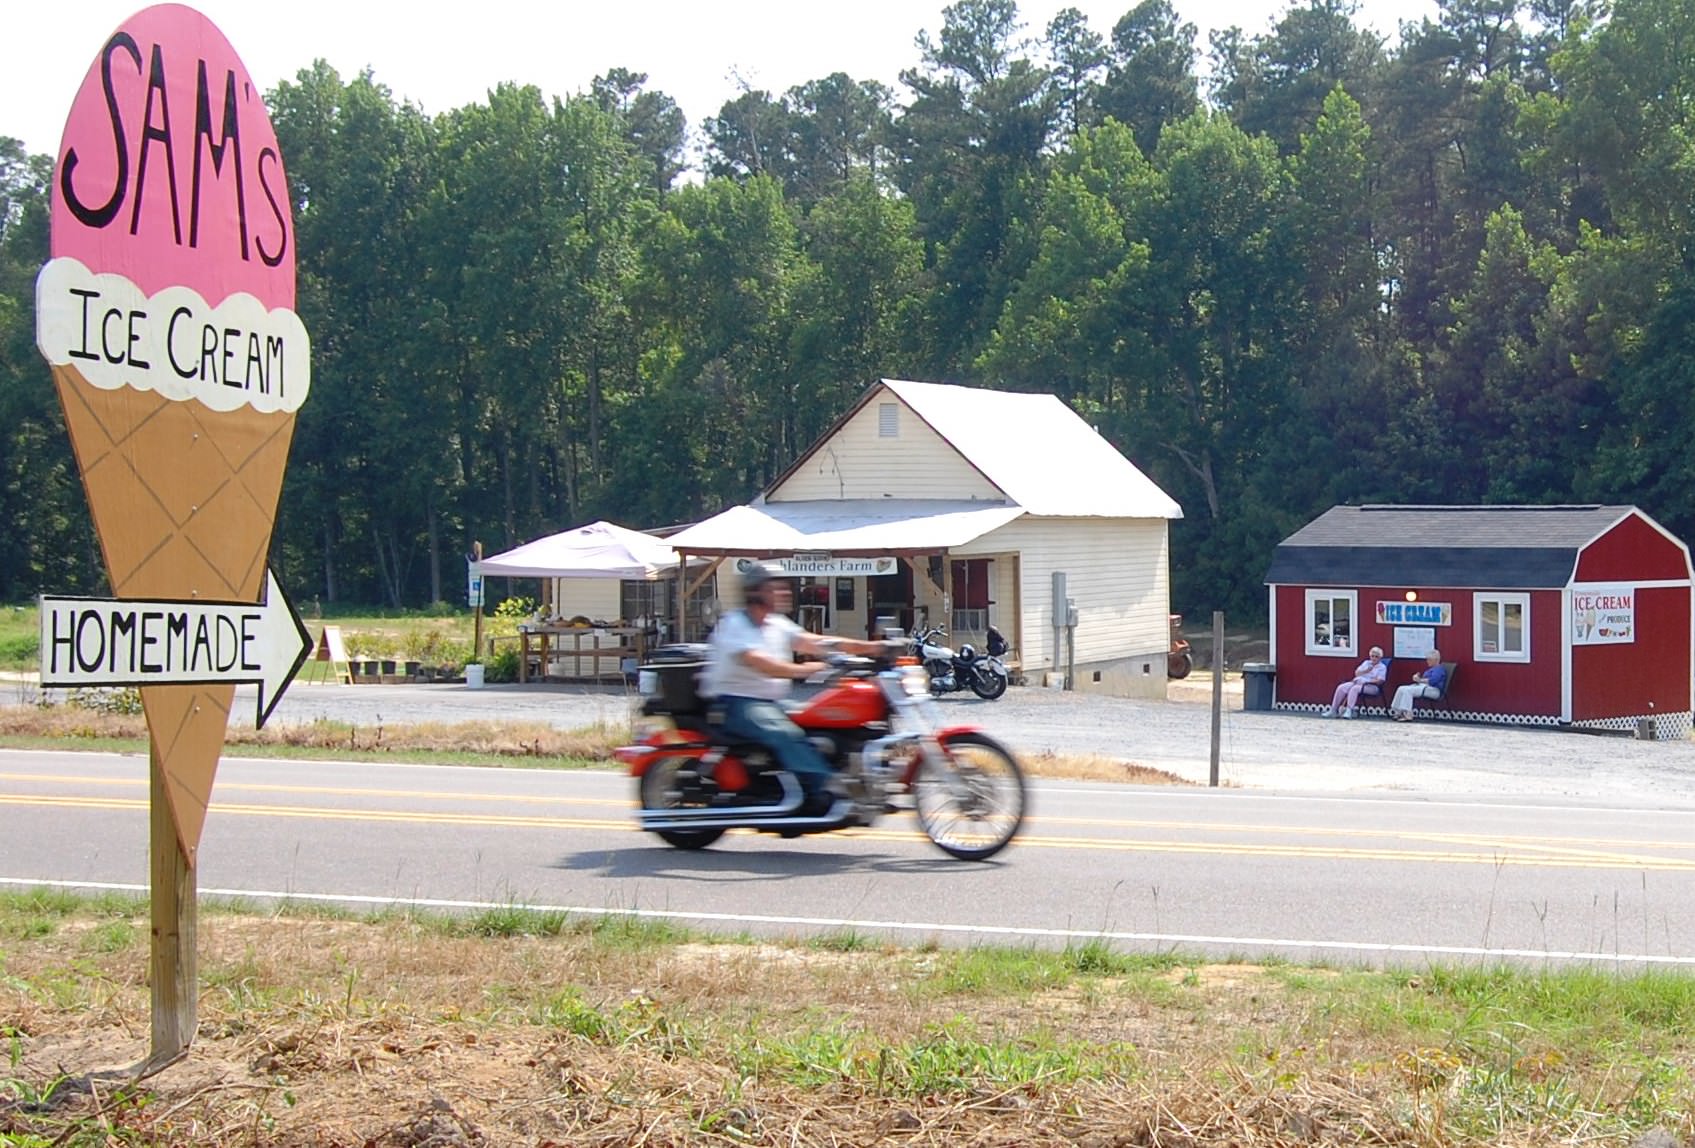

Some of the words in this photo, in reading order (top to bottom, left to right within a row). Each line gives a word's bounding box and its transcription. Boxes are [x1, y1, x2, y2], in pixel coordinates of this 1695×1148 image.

[61, 31, 287, 267] SAM'S
[68, 288, 150, 370] ICE
[167, 306, 284, 398] CREAM
[780, 561, 834, 573] hlanders
[840, 561, 872, 572] Farm
[1386, 604, 1402, 622] ICE
[1405, 605, 1441, 623] CREAM
[1574, 596, 1595, 611] ICE
[1595, 596, 1631, 610] CREAM
[50, 609, 262, 674] HOMEMADE
